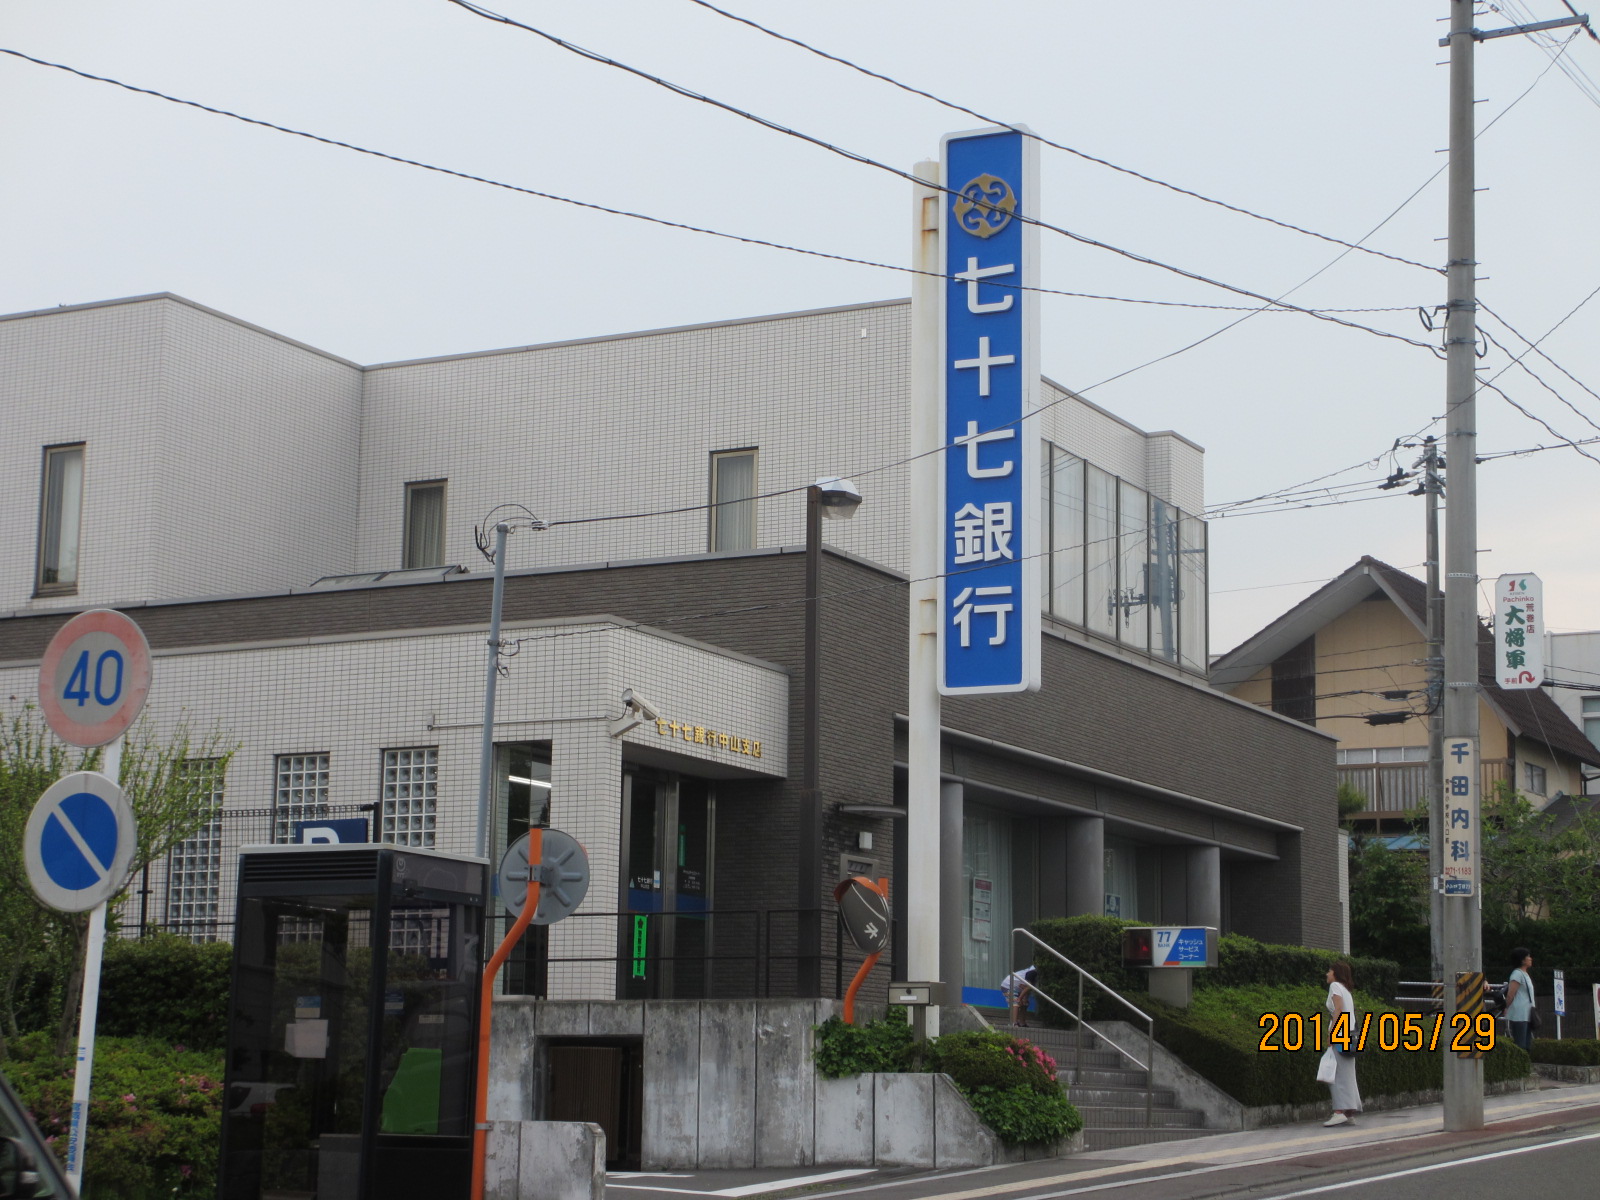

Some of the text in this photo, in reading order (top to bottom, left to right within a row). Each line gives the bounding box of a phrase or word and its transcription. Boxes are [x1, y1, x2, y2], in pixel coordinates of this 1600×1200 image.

[953, 256, 1016, 648] 七十七銀行
[1504, 605, 1526, 670] 大将軍
[1526, 603, 1535, 634] 荒巻店
[63, 649, 124, 707] 40
[656, 717, 762, 757] 七十七銀行中山支店
[1450, 742, 1470, 862] 千田内科
[1157, 931, 1171, 943] 77
